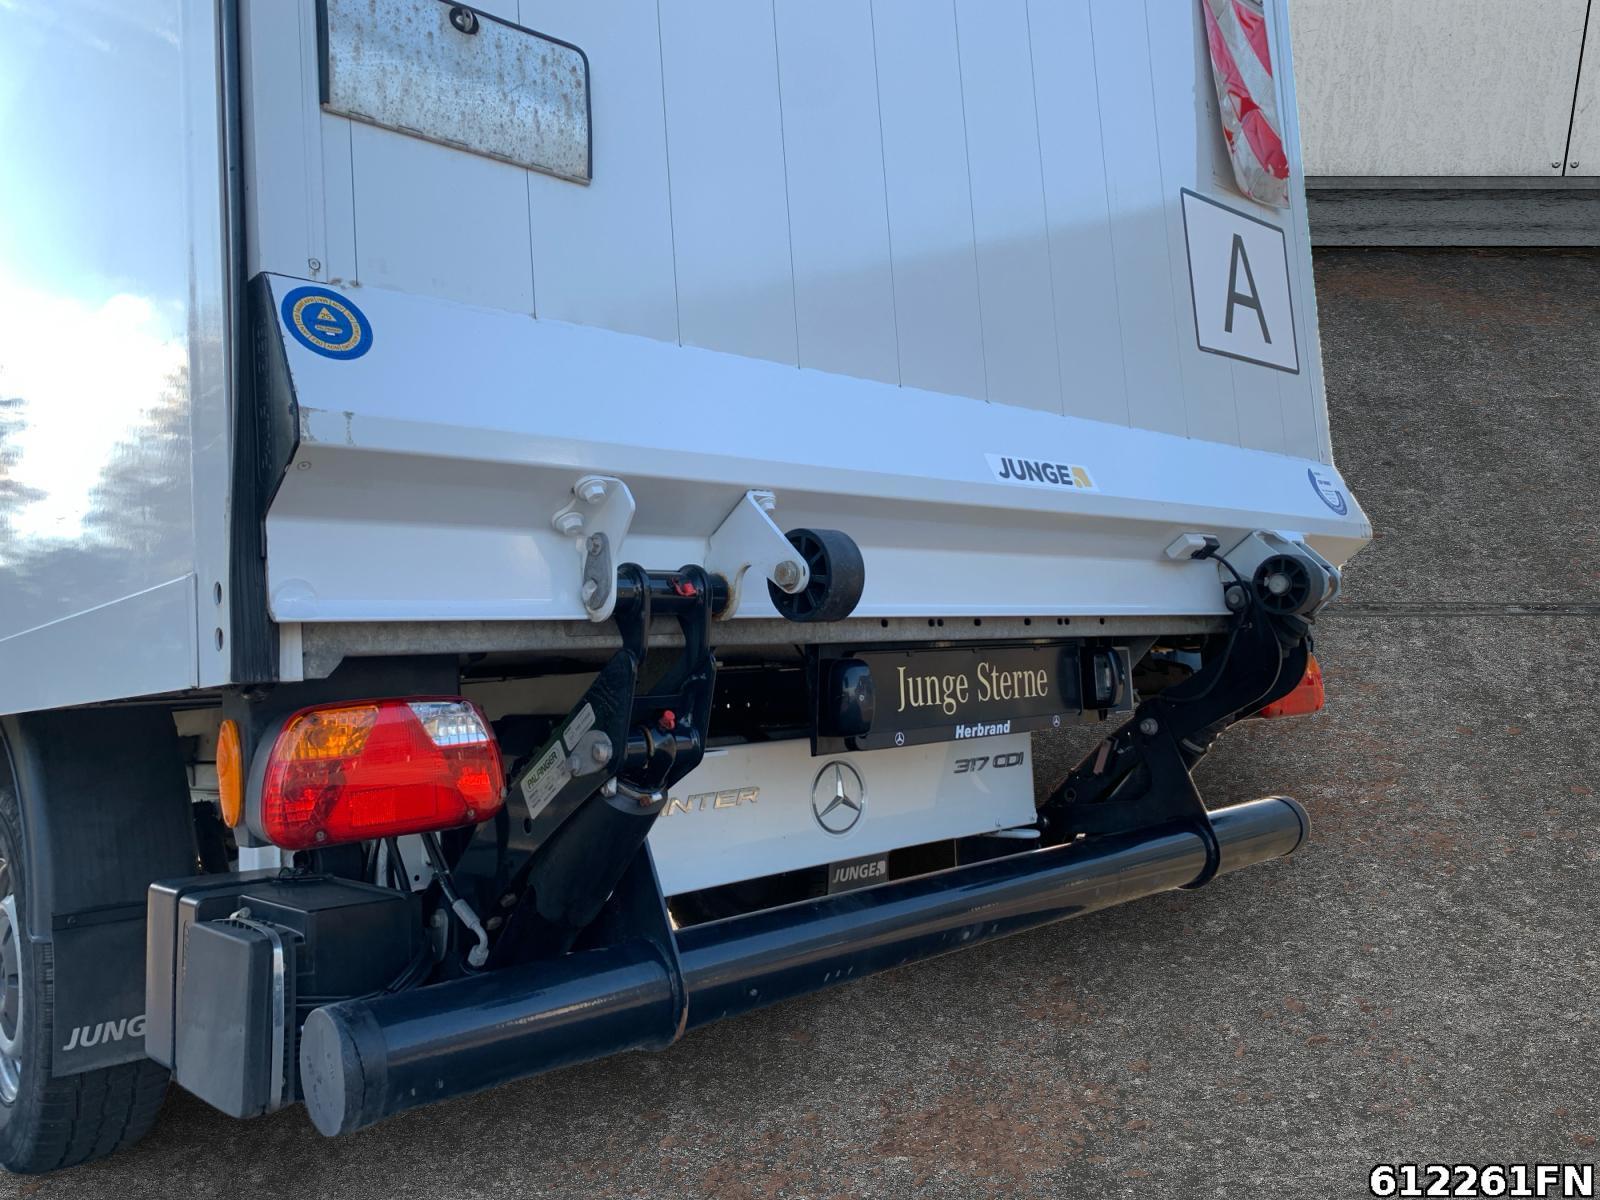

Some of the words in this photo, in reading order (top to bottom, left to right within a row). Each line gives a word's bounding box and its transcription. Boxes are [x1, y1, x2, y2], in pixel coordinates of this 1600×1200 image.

[1224, 232, 1273, 345] A
[998, 457, 1074, 486] JUNGE
[896, 665, 969, 715] Junge
[976, 661, 1049, 702] Sterne
[955, 719, 1011, 739] Herbrand
[953, 755, 989, 774] 317
[992, 751, 1024, 769] CDI
[660, 786, 760, 817] INTER
[832, 861, 877, 884] JUNGE
[62, 1014, 146, 1052] JUNG
